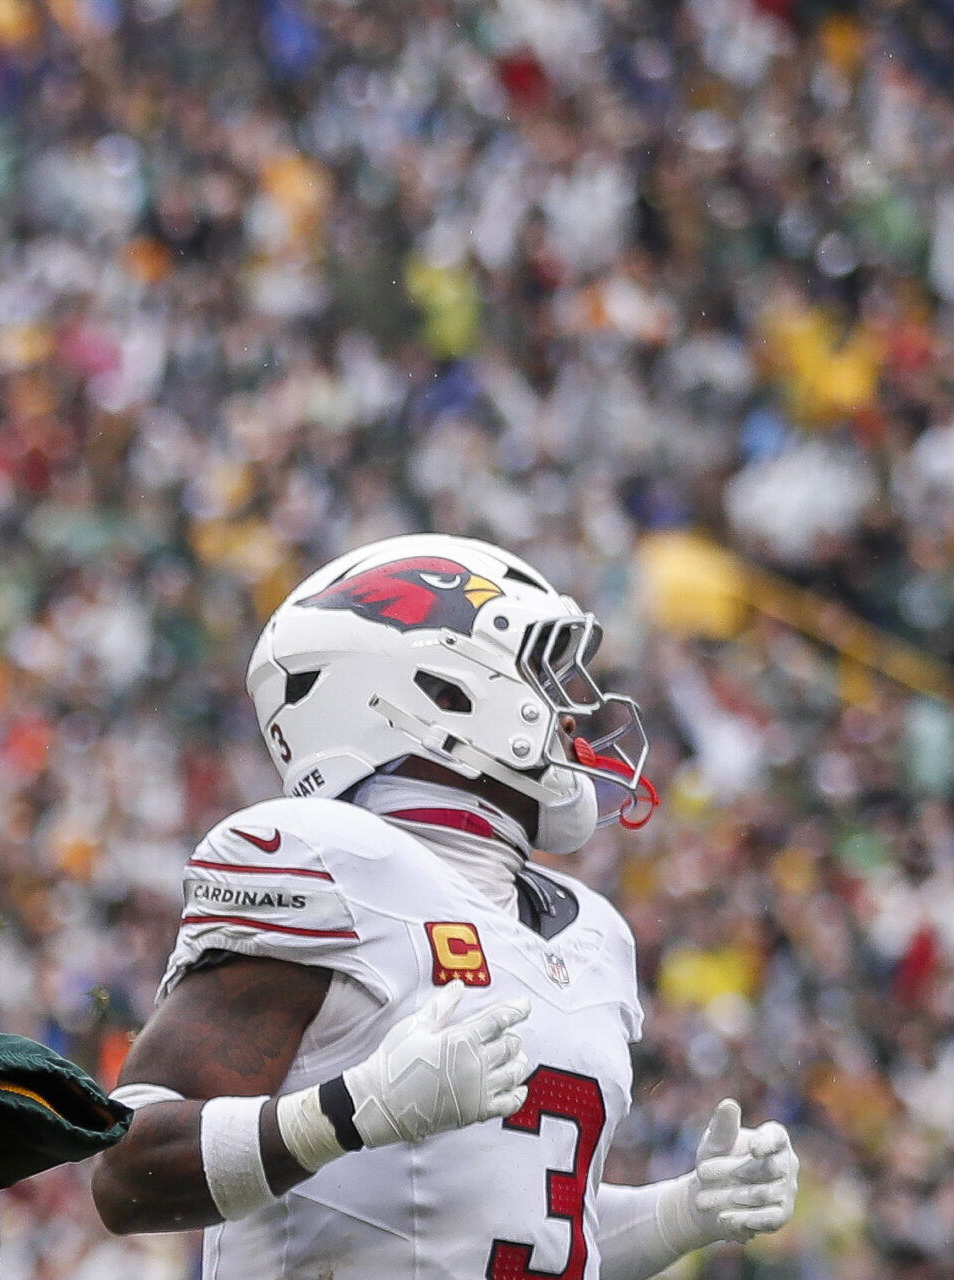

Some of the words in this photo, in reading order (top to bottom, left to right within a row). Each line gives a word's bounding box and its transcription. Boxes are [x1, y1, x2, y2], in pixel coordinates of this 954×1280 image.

[270, 723, 292, 764] 3
[194, 885, 306, 909] CARDINALS
[432, 924, 483, 970] C
